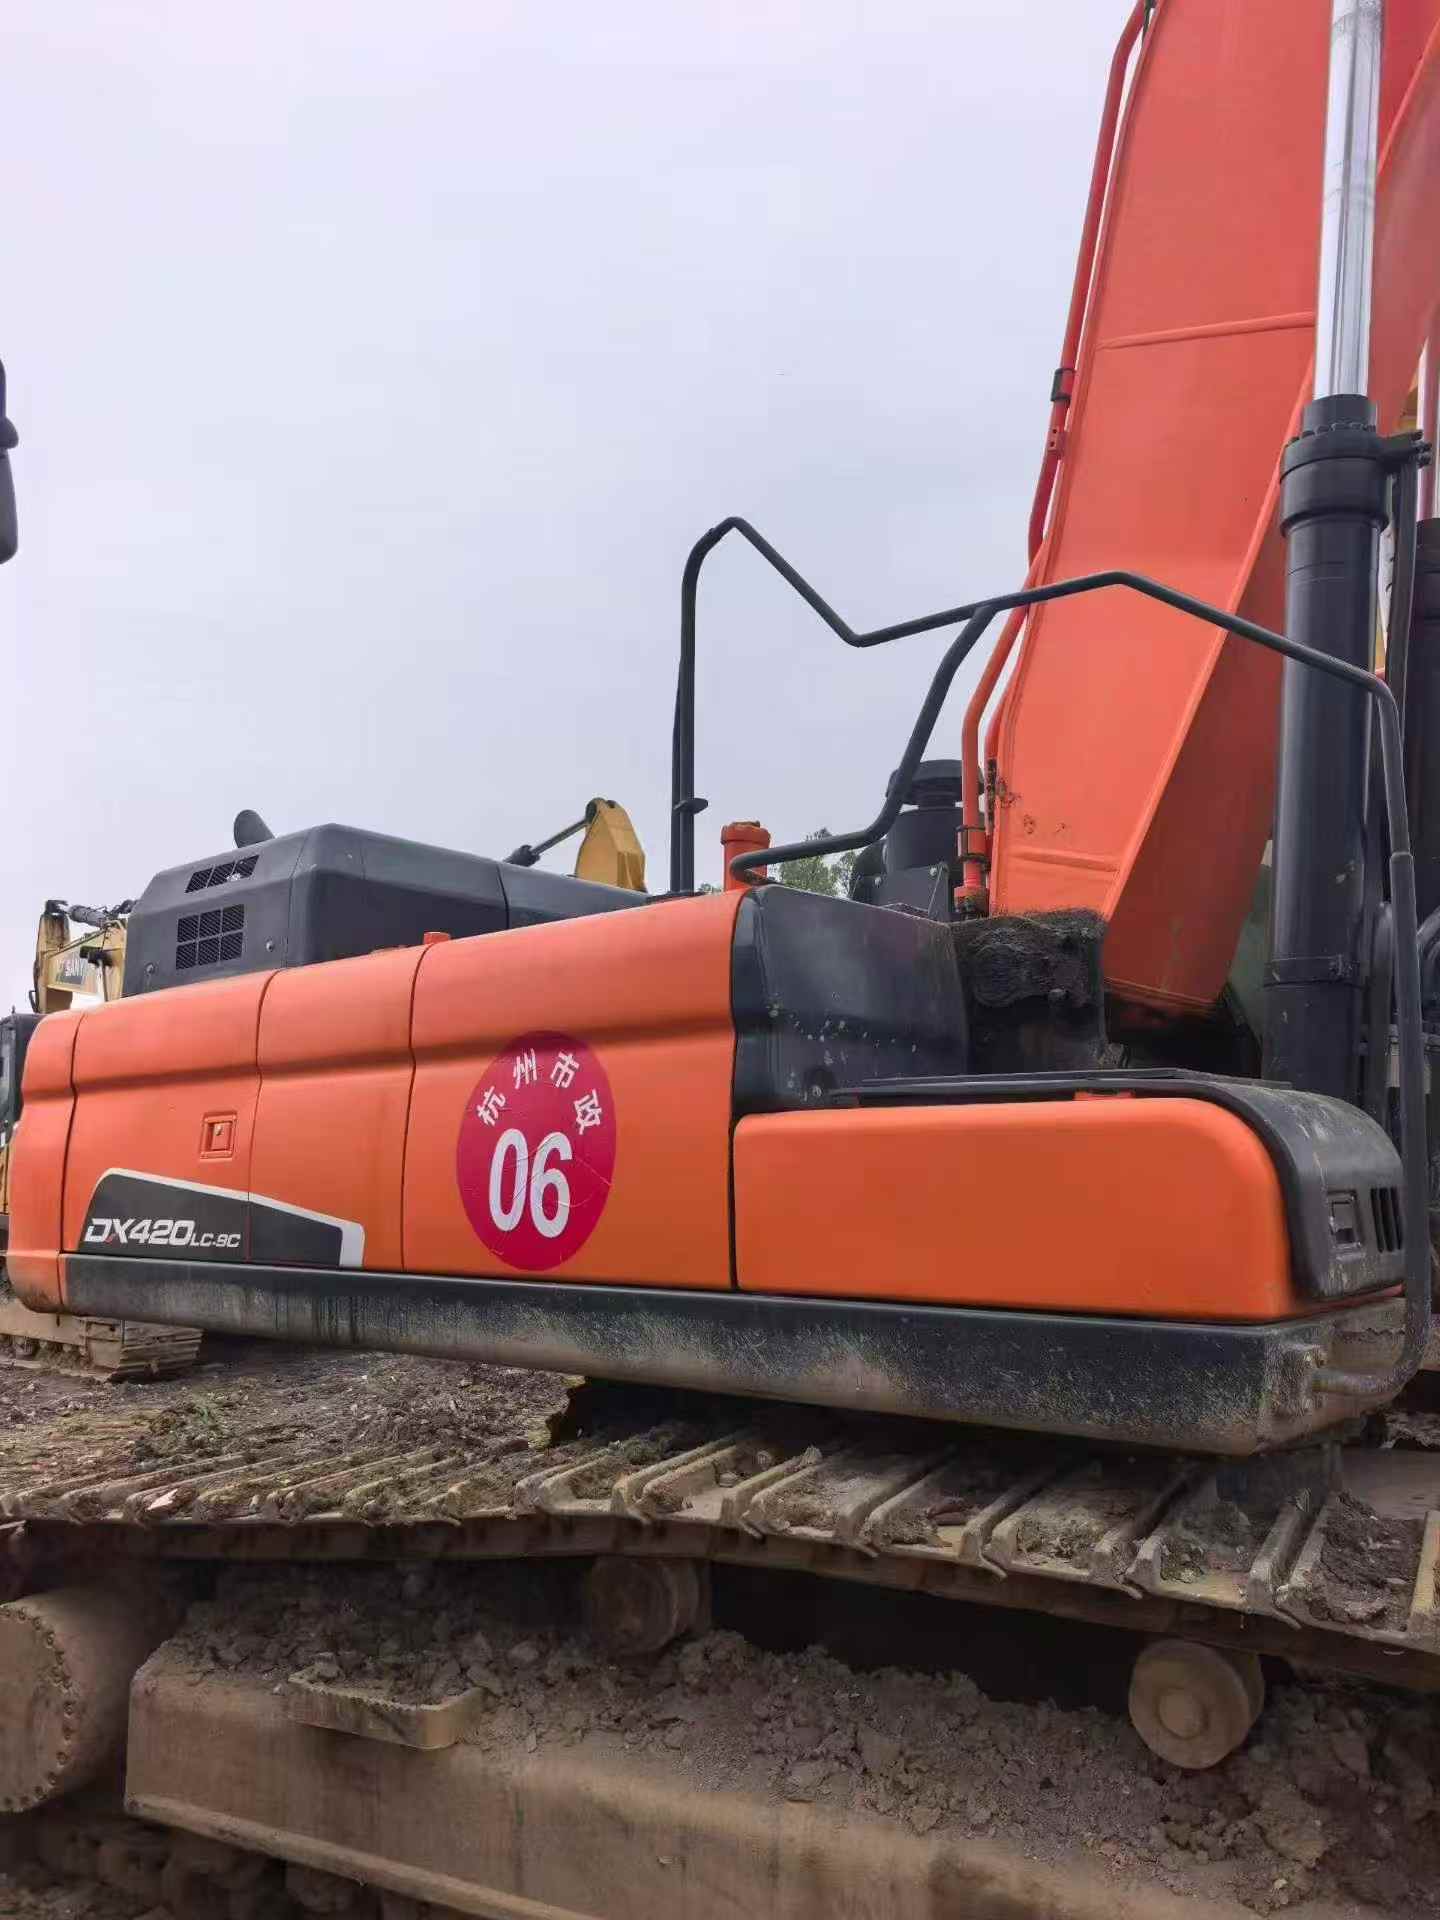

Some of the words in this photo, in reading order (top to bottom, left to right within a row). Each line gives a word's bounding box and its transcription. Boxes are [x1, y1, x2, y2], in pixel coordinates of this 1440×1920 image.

[476, 1049, 603, 1135] 杭州市政
[488, 1128, 573, 1238] 06
